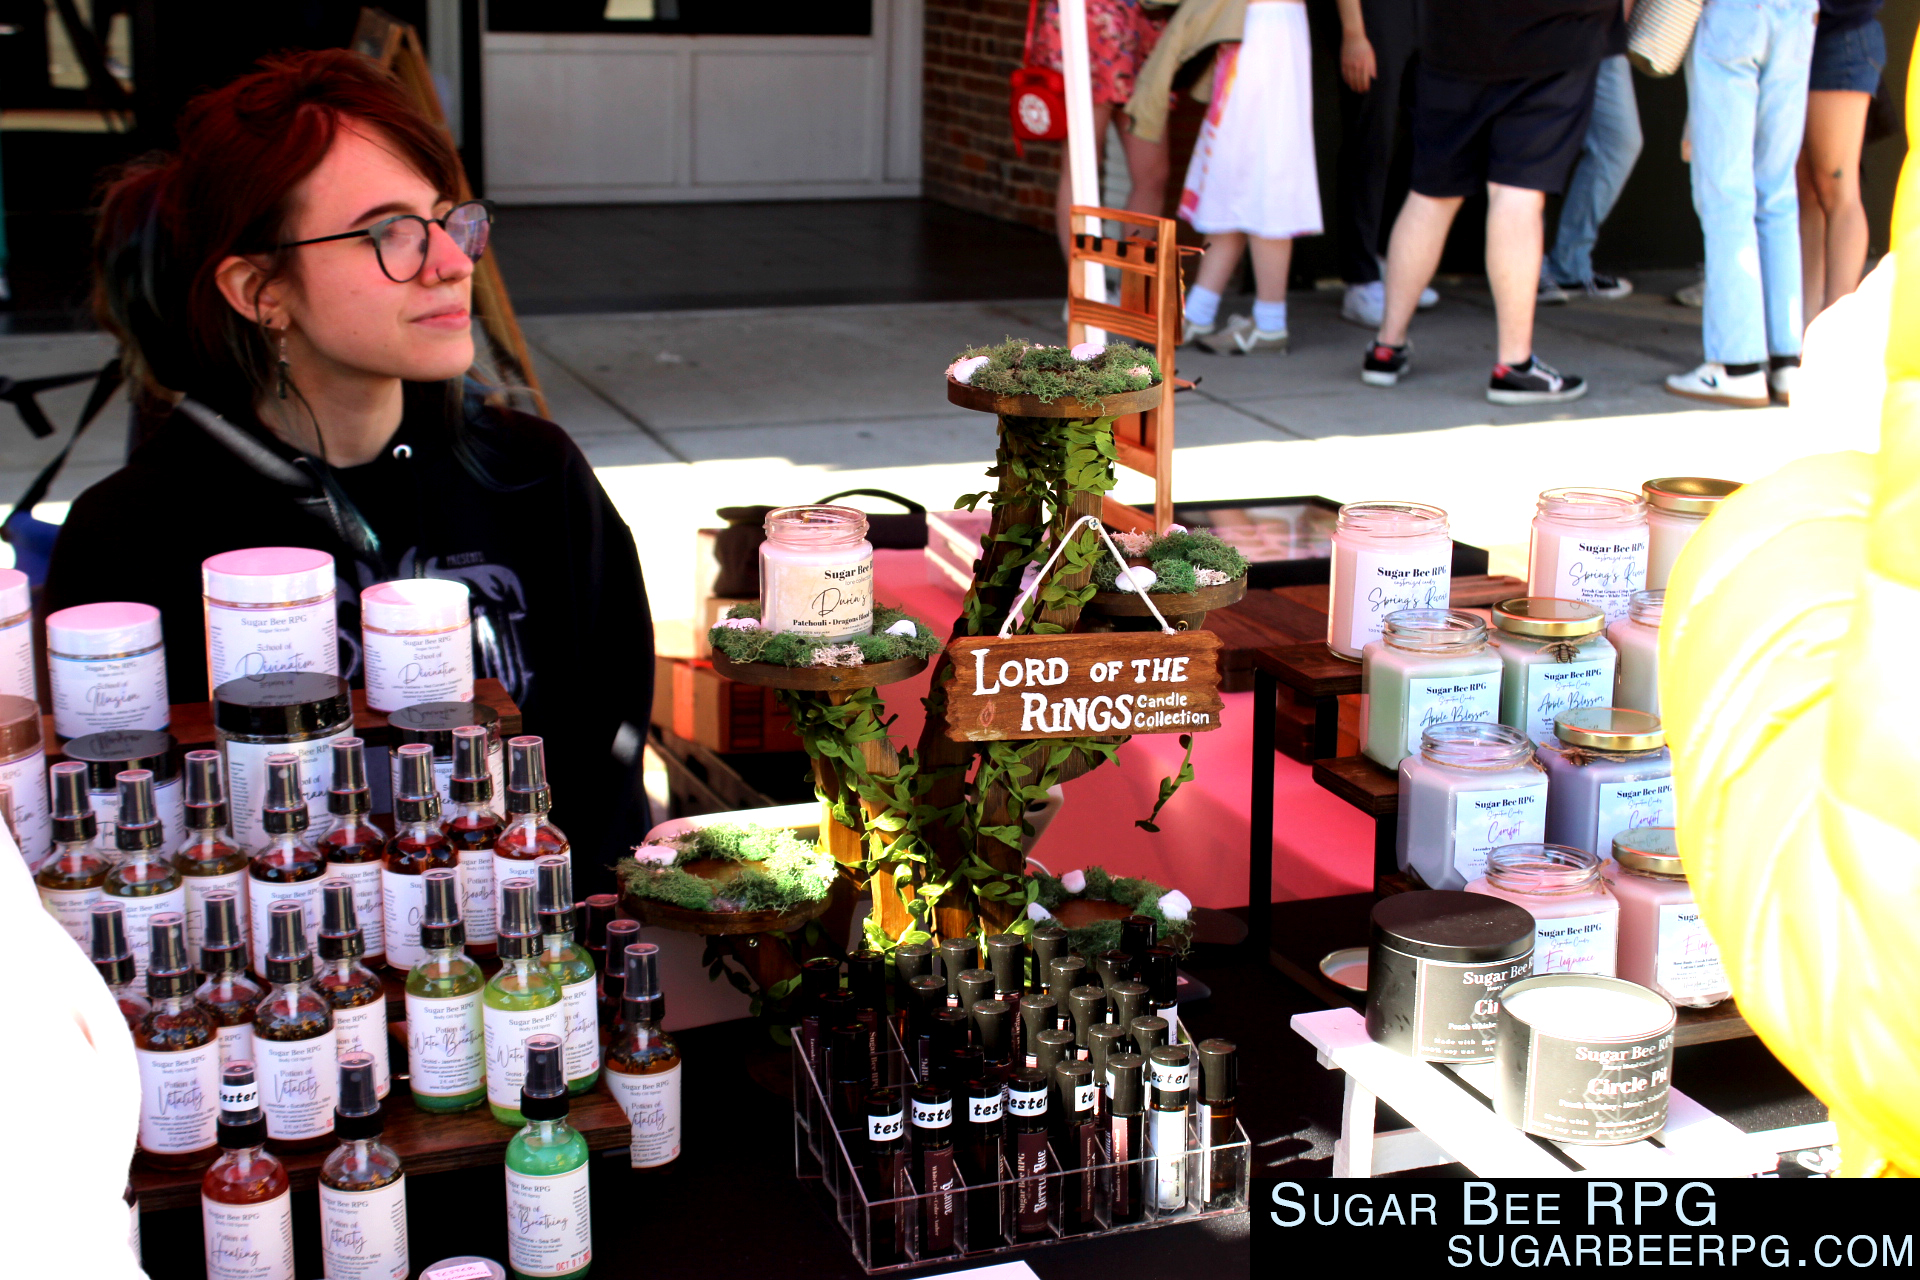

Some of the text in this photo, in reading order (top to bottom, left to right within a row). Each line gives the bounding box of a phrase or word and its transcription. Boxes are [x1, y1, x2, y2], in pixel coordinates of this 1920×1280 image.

[1579, 542, 1645, 554] Sugar Bee RPG
[824, 565, 870, 581] Sugar Bee
[1377, 565, 1447, 579] Sugar Bee RPG
[1569, 562, 1619, 587] Spring's
[1368, 587, 1420, 612] Spring's
[241, 615, 307, 627] Sugar Bee RPG
[793, 611, 870, 627] Patchouli Dragons Blood
[970, 648, 1190, 696] LORD OF THE
[1544, 668, 1602, 682] Sugar Bee RPG
[1426, 686, 1452, 695] Sugar
[1469, 682, 1487, 691] RPG
[1537, 691, 1605, 715] Apple Blossom
[1020, 691, 1188, 733] RINGS Candle
[1420, 705, 1490, 726] Apple Blossom
[1133, 710, 1210, 729] Collection
[1616, 788, 1657, 799] Sugar Bee
[1475, 795, 1535, 811] Sugar Bee RPG
[1628, 809, 1663, 829] Comfort
[1487, 820, 1525, 843] Comfort
[509, 867, 528, 875] Sugar
[190, 884, 211, 892] Sugar
[271, 892, 292, 900] Sugar
[155, 901, 169, 910] RPG
[1678, 913, 1698, 922] Suga
[1538, 923, 1602, 939] Sugar Bee RPG
[1463, 963, 1527, 987] Sugar Bee
[574, 991, 587, 999] RPG
[424, 1007, 445, 1016] Sugar
[461, 1002, 474, 1011] RPG
[546, 1013, 557, 1021] RPG
[436, 1026, 457, 1034] Potion
[1448, 1023, 1471, 1031] Peach
[224, 1034, 241, 1042] RPG
[1434, 1037, 1456, 1045] Made
[269, 1045, 321, 1057] Sugar Bee RPG
[1443, 1047, 1458, 1056] soy
[1575, 1045, 1656, 1065] Sugar Bee
[152, 1060, 174, 1069] Sugar
[191, 1054, 206, 1064] RPG
[921, 1058, 929, 1076] RPG
[280, 1067, 312, 1077] Potion of
[1151, 1071, 1189, 1084] ester
[164, 1078, 198, 1089] Potion of
[621, 1082, 641, 1091] Sugar
[656, 1080, 669, 1088] RPG
[1587, 1067, 1668, 1096] Circle Pit
[1559, 1099, 1583, 1110] Peach
[913, 1106, 951, 1122] teste
[1543, 1113, 1590, 1126] Made with
[1554, 1125, 1590, 1136] soy wax
[520, 1183, 533, 1191] Bee
[1018, 1188, 1027, 1214] Sugar
[217, 1232, 239, 1241] Potion
